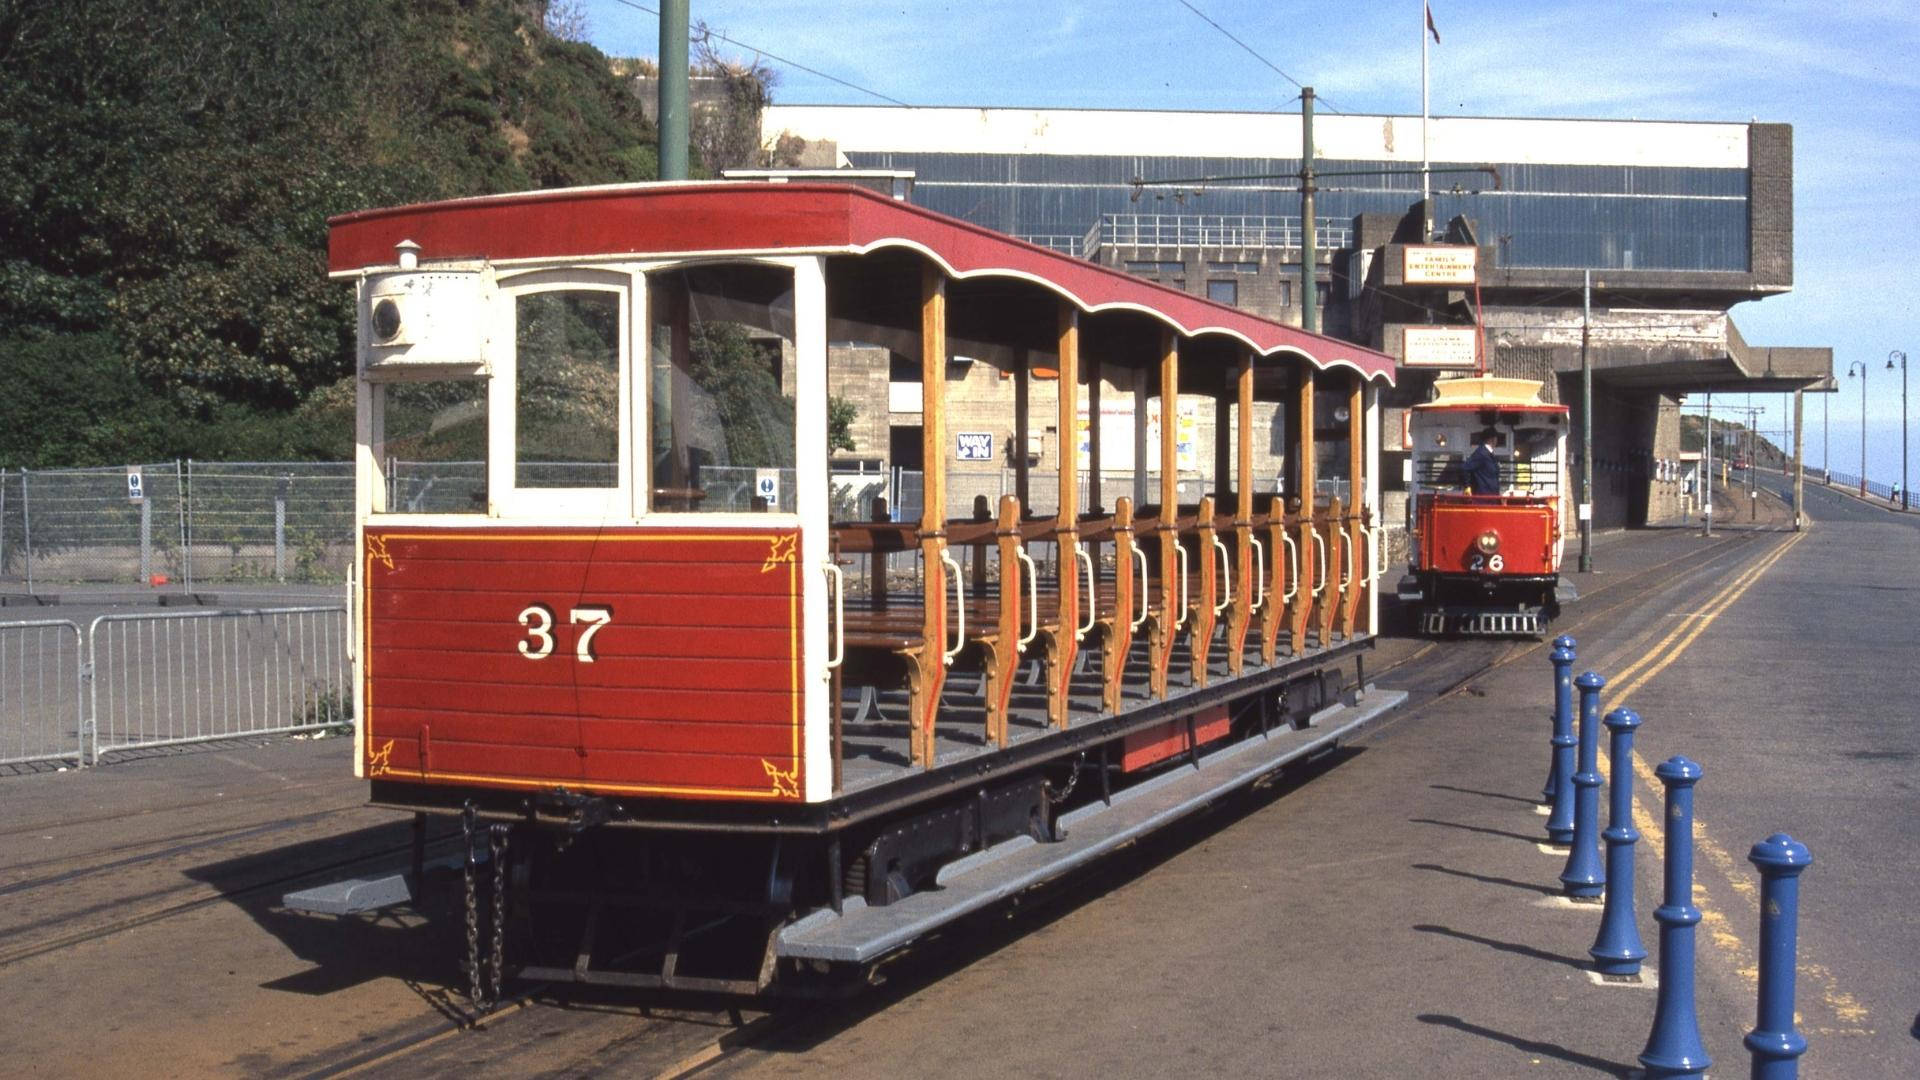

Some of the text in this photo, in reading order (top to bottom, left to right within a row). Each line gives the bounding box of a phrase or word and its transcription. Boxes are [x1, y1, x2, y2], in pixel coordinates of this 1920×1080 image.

[959, 435, 991, 448] WAY
[972, 446, 990, 458] IN
[1470, 554, 1504, 572] 26
[518, 605, 613, 663] 37
